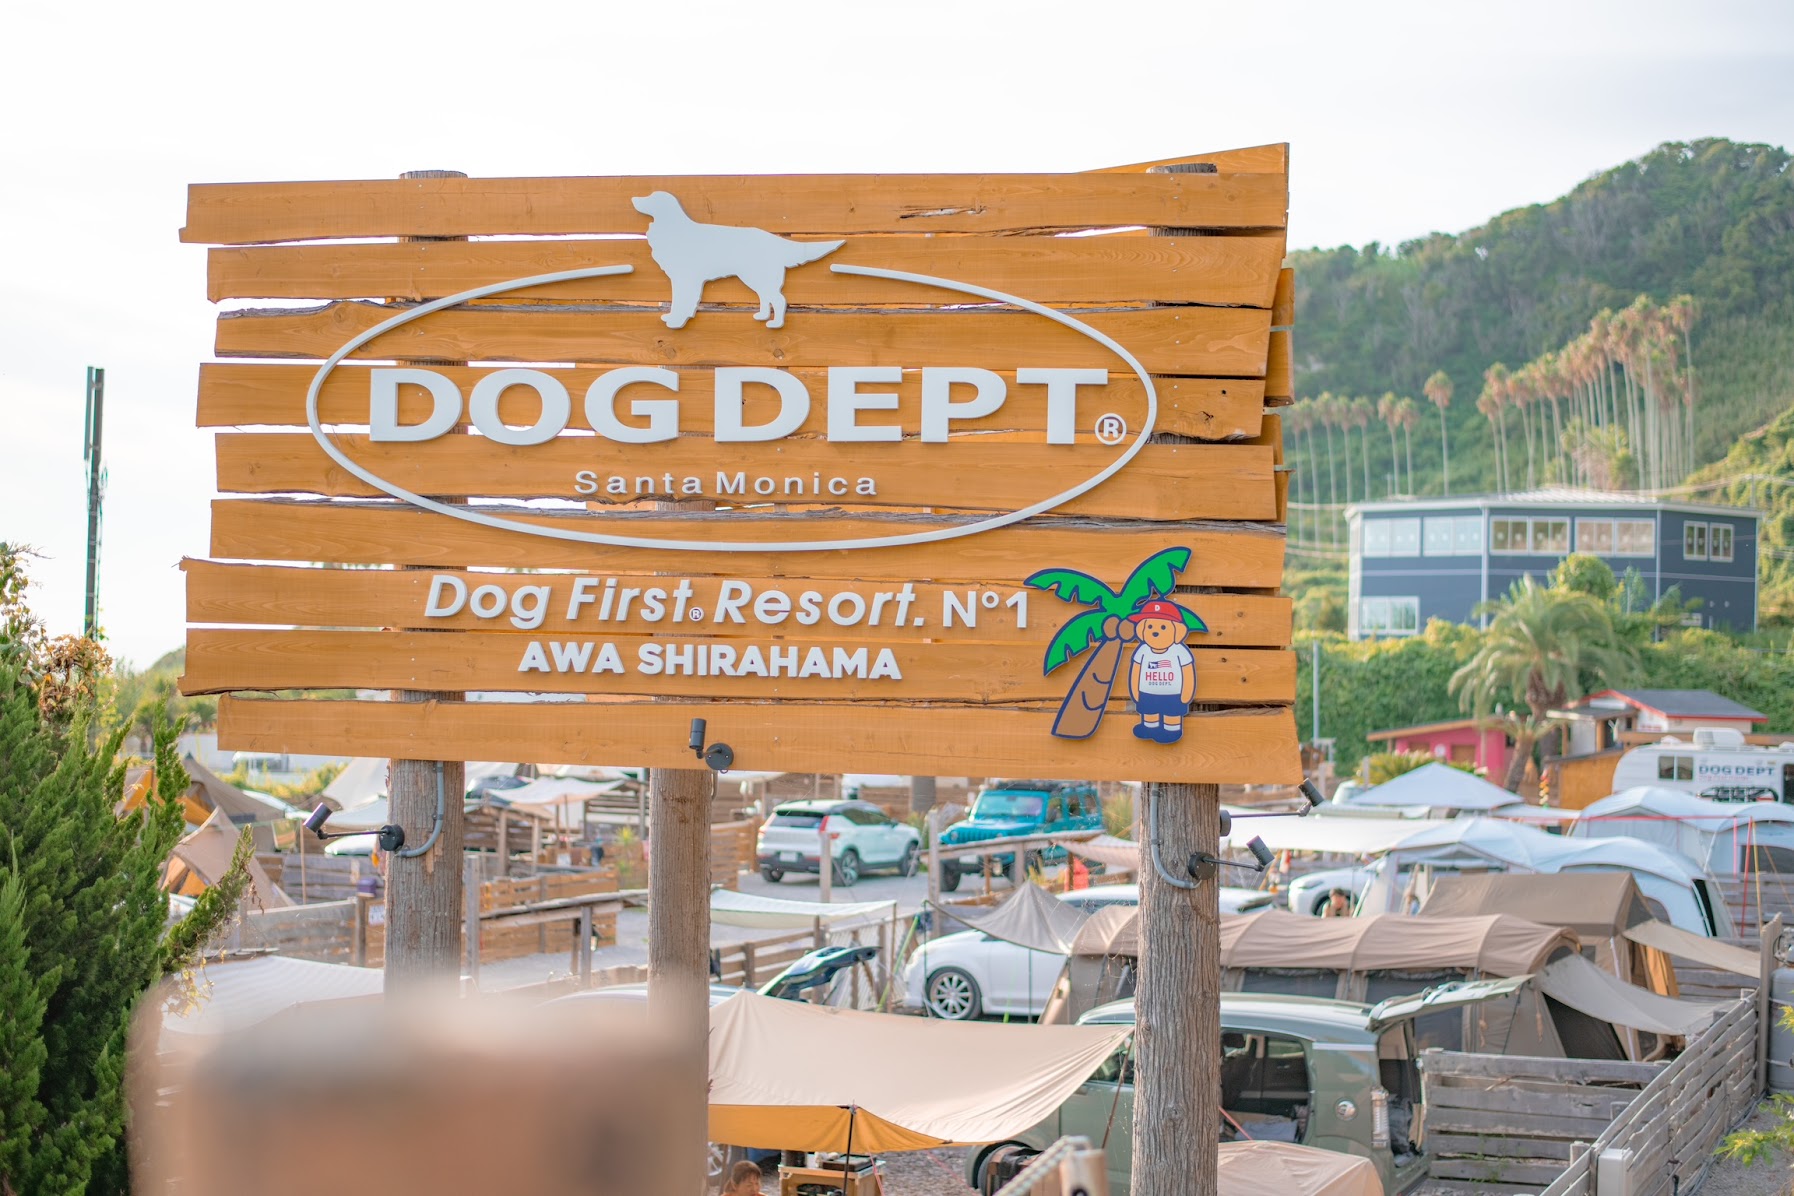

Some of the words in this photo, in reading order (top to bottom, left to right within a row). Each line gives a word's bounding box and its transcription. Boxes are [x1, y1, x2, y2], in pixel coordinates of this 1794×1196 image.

[369, 366, 680, 445] DOG
[574, 469, 703, 496] Santa
[715, 470, 878, 497] Monica
[424, 574, 551, 630] Dog
[713, 580, 925, 626] Resort.
[517, 641, 625, 674] AWA
[637, 643, 902, 680] SHIRAHAMA
[1145, 671, 1174, 681] HELLO
[1699, 765, 1731, 775] DOG
[1735, 766, 1775, 776] DEPT
